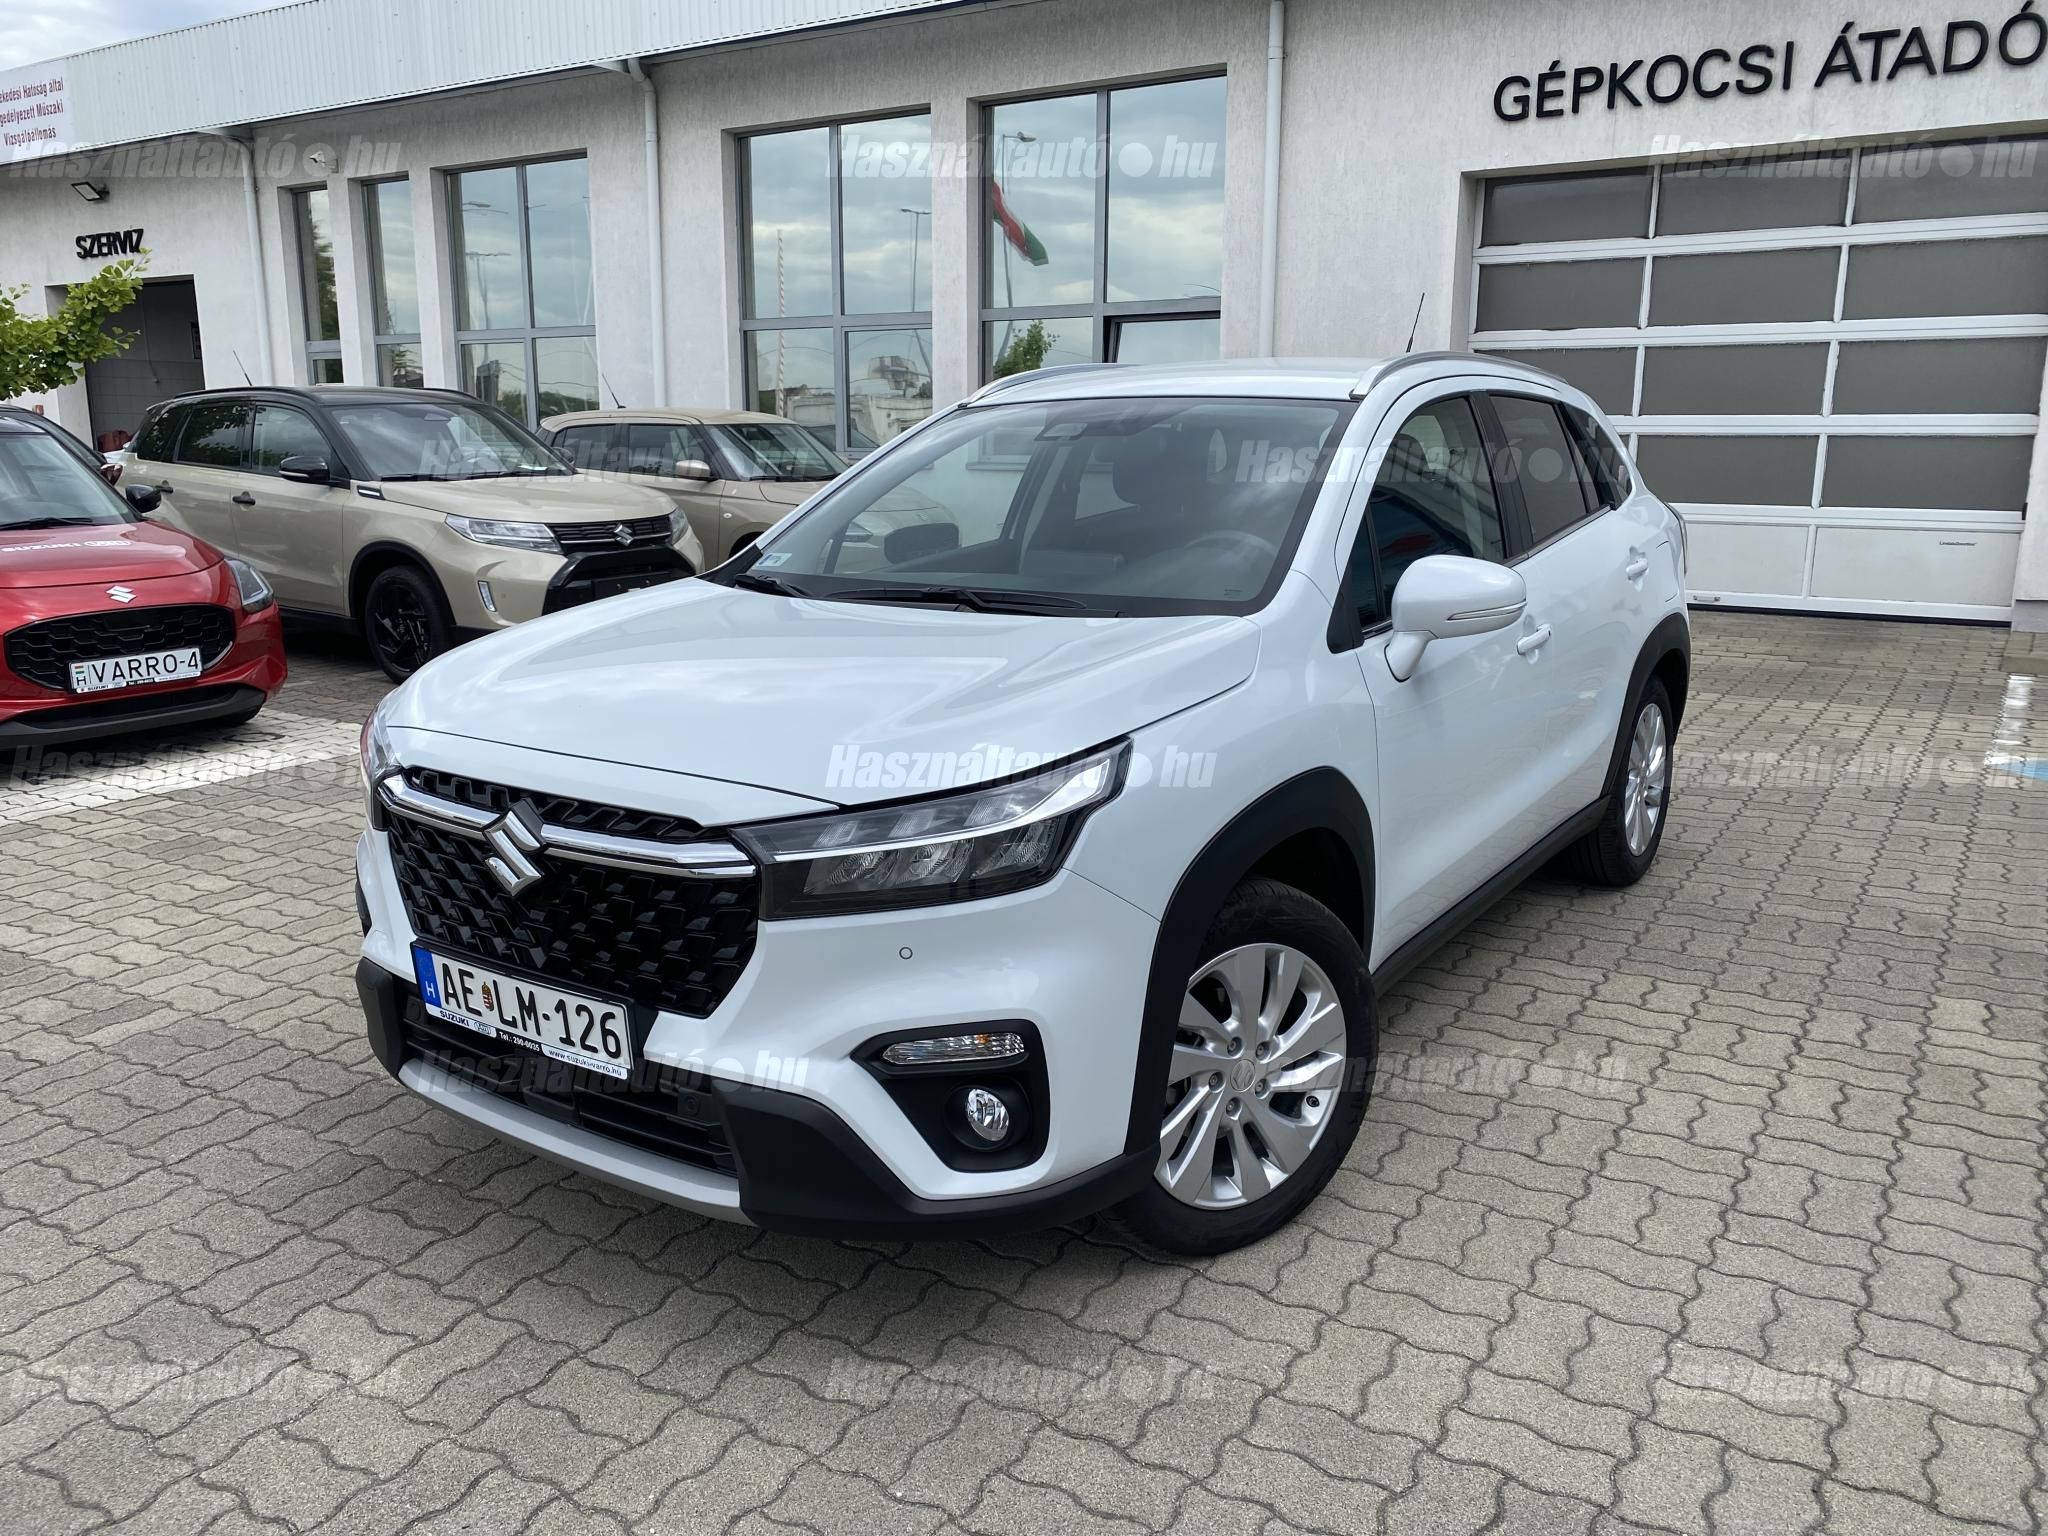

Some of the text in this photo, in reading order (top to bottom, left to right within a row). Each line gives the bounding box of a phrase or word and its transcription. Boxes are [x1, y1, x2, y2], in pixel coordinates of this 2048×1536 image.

[1493, 0, 2048, 122] GÉPKOCSI ÁTADÓ
[23, 81, 48, 98] Hatóság
[49, 76, 64, 93] által
[4, 124, 57, 147] Vizsgálóállomás
[75, 228, 144, 259] SZERVIZ
[92, 652, 199, 683] VARRO-4
[425, 981, 436, 999] H
[440, 1010, 470, 1027] SUZUKI
[493, 979, 621, 1059] LM-126
